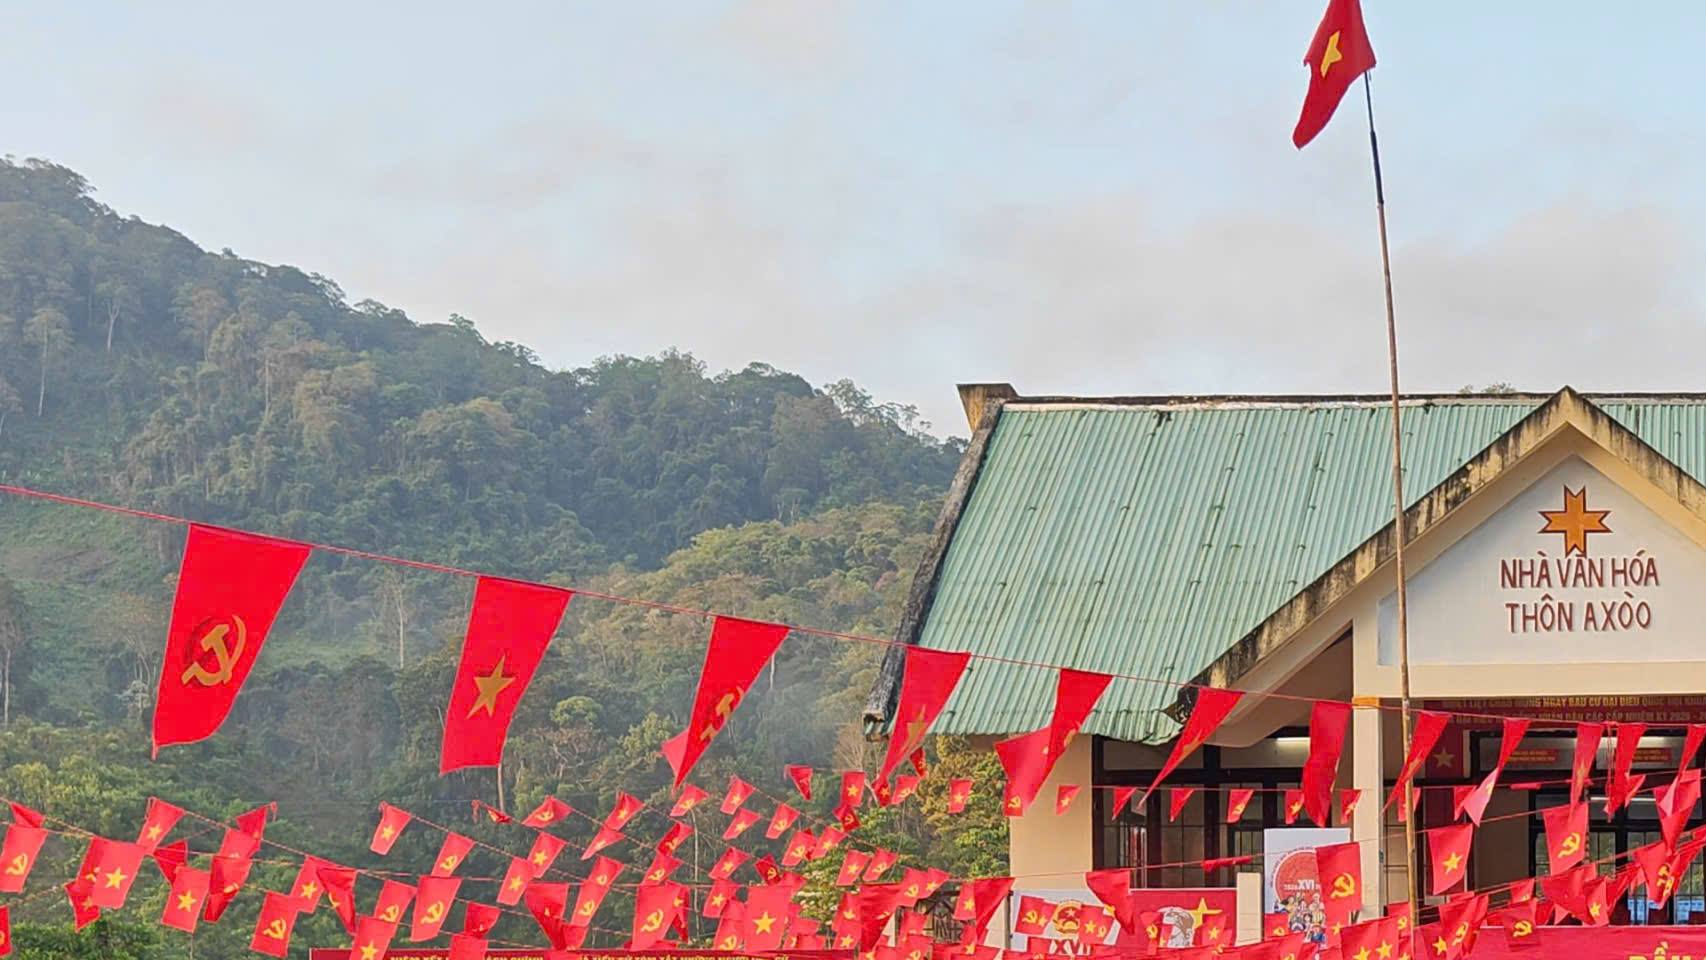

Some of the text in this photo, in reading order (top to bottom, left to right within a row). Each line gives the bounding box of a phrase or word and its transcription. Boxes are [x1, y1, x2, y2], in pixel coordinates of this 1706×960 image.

[1501, 551, 1552, 588] NHÀ
[1612, 550, 1660, 587] HÓA
[1505, 593, 1573, 633] THÔN
